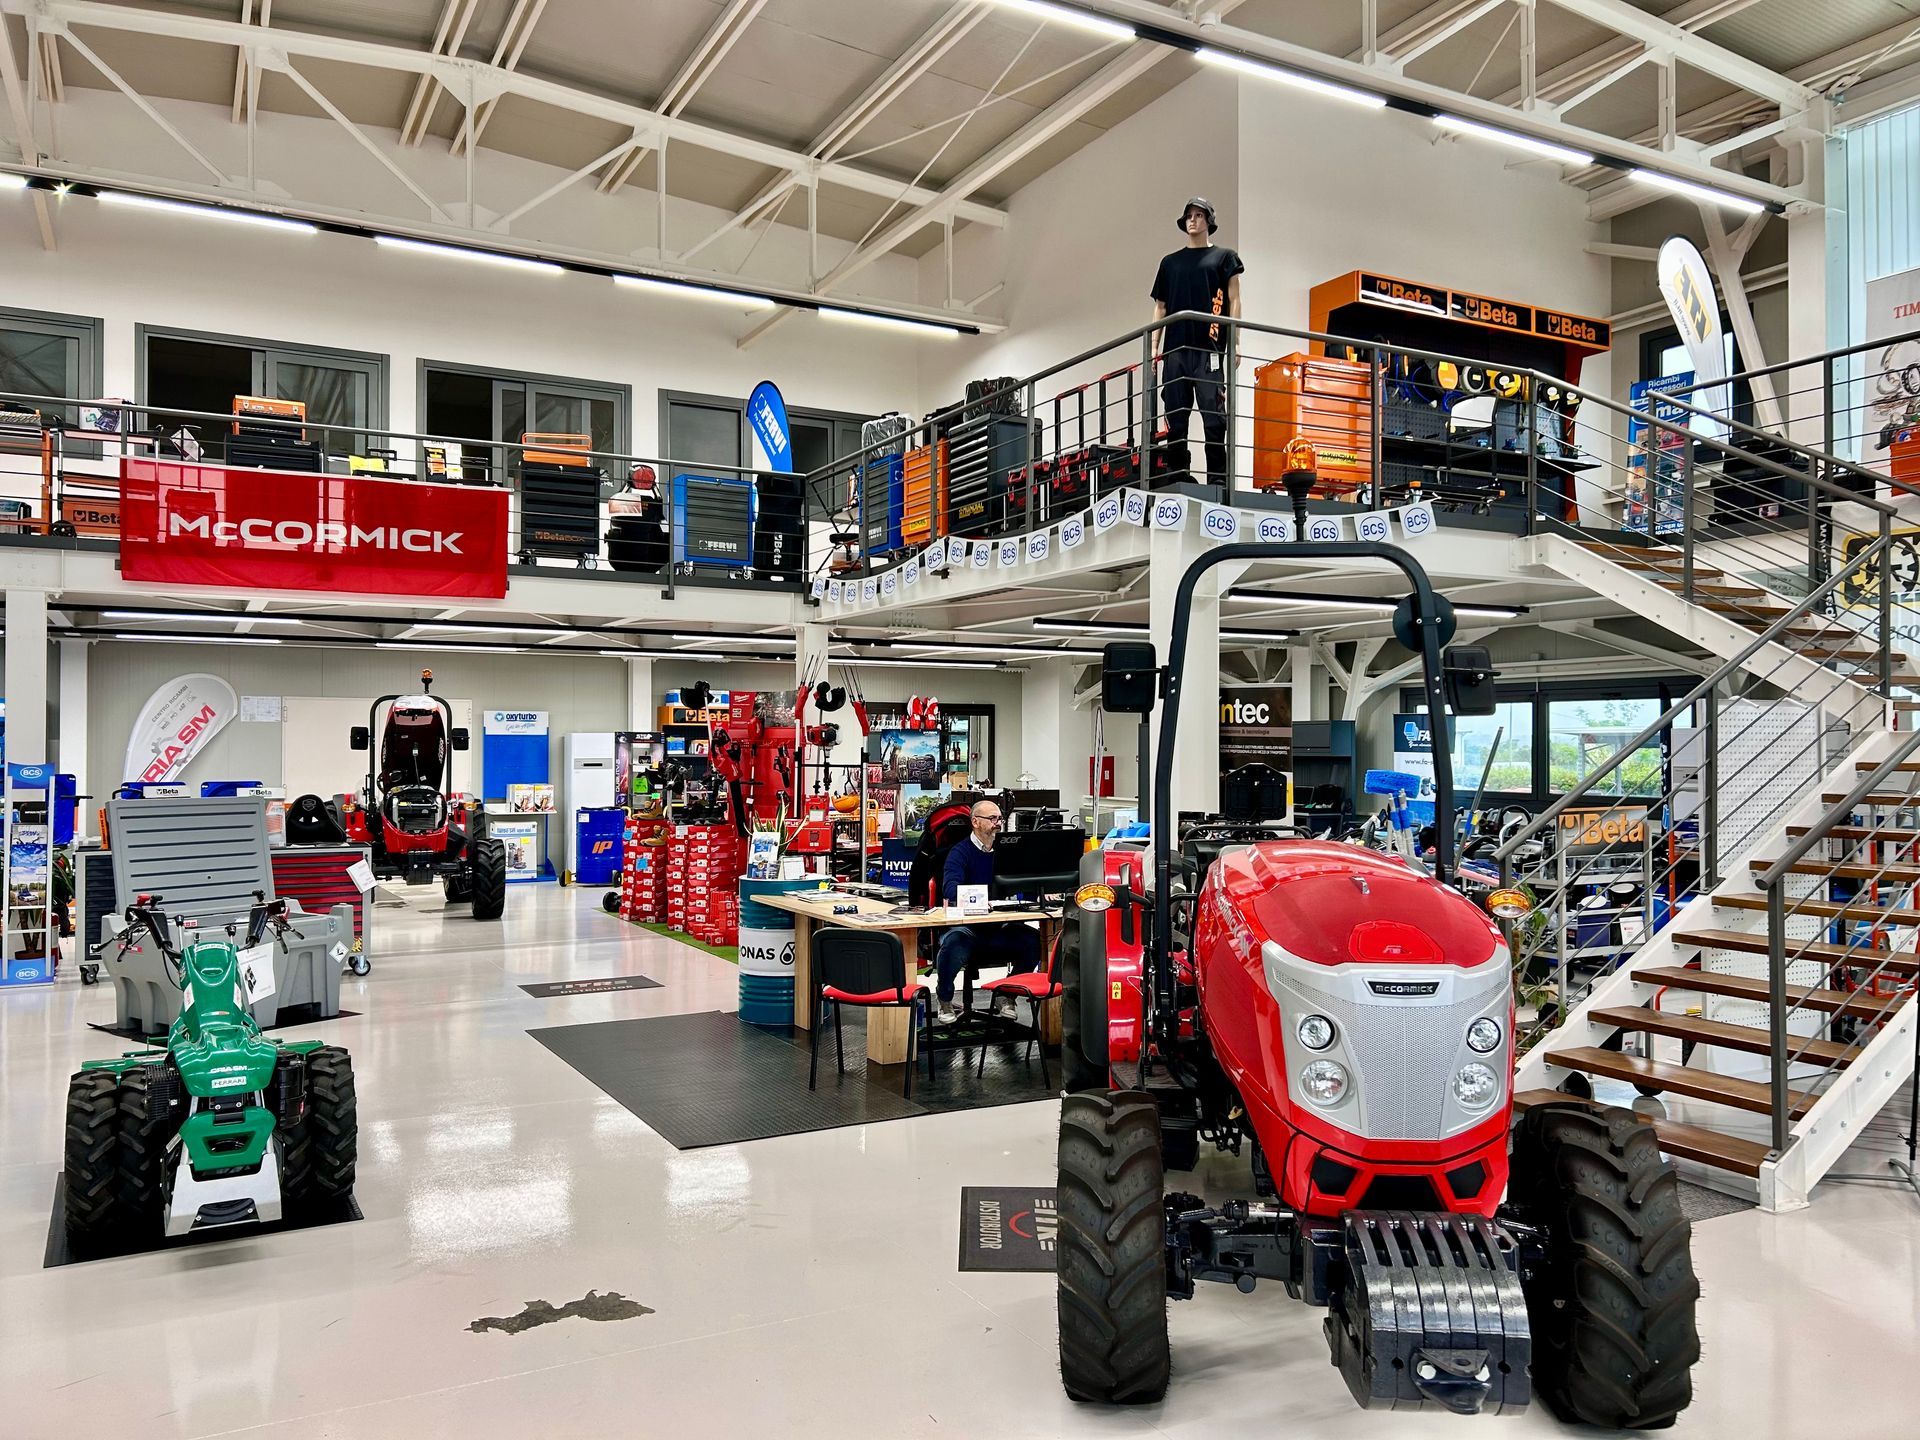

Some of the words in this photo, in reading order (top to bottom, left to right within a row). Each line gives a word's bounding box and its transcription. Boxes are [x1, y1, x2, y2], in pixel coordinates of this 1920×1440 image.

[1391, 283, 1433, 305] Beta
[1480, 301, 1517, 327] Beta
[1561, 320, 1597, 342] Beta
[1647, 375, 1680, 389] Ricambi
[760, 403, 787, 454] FERVI
[1099, 504, 1117, 523] BCS
[1128, 499, 1143, 515] BCS
[1158, 507, 1181, 520] BCS
[88, 510, 120, 524] Bet
[1208, 516, 1234, 531] BCS
[1407, 513, 1427, 528] BCS
[170, 512, 464, 554] McCORMICK
[1064, 524, 1081, 540] BCS
[1261, 525, 1286, 538] BCS
[1313, 527, 1337, 540] BCS
[1363, 522, 1385, 536] BCS
[1030, 540, 1047, 552] BCS
[773, 541, 783, 566] Beta
[927, 550, 943, 566] BCS
[506, 712, 537, 721] oxyturbo
[698, 709, 729, 722] Beta
[1220, 698, 1270, 724] ntec
[141, 746, 184, 782] RIA
[178, 705, 217, 745] SM
[22, 769, 41, 777] BCS
[162, 788, 179, 796] Beta
[255, 788, 272, 797] Beta
[1584, 813, 1645, 844] Beta
[1000, 836, 1021, 844] acer
[592, 841, 613, 854] IP
[18, 970, 37, 979] BCS
[1375, 985, 1434, 993] McCORMICK
[214, 1078, 245, 1087] FERRARI
[979, 1200, 1003, 1250] DISTRIBUTOR
